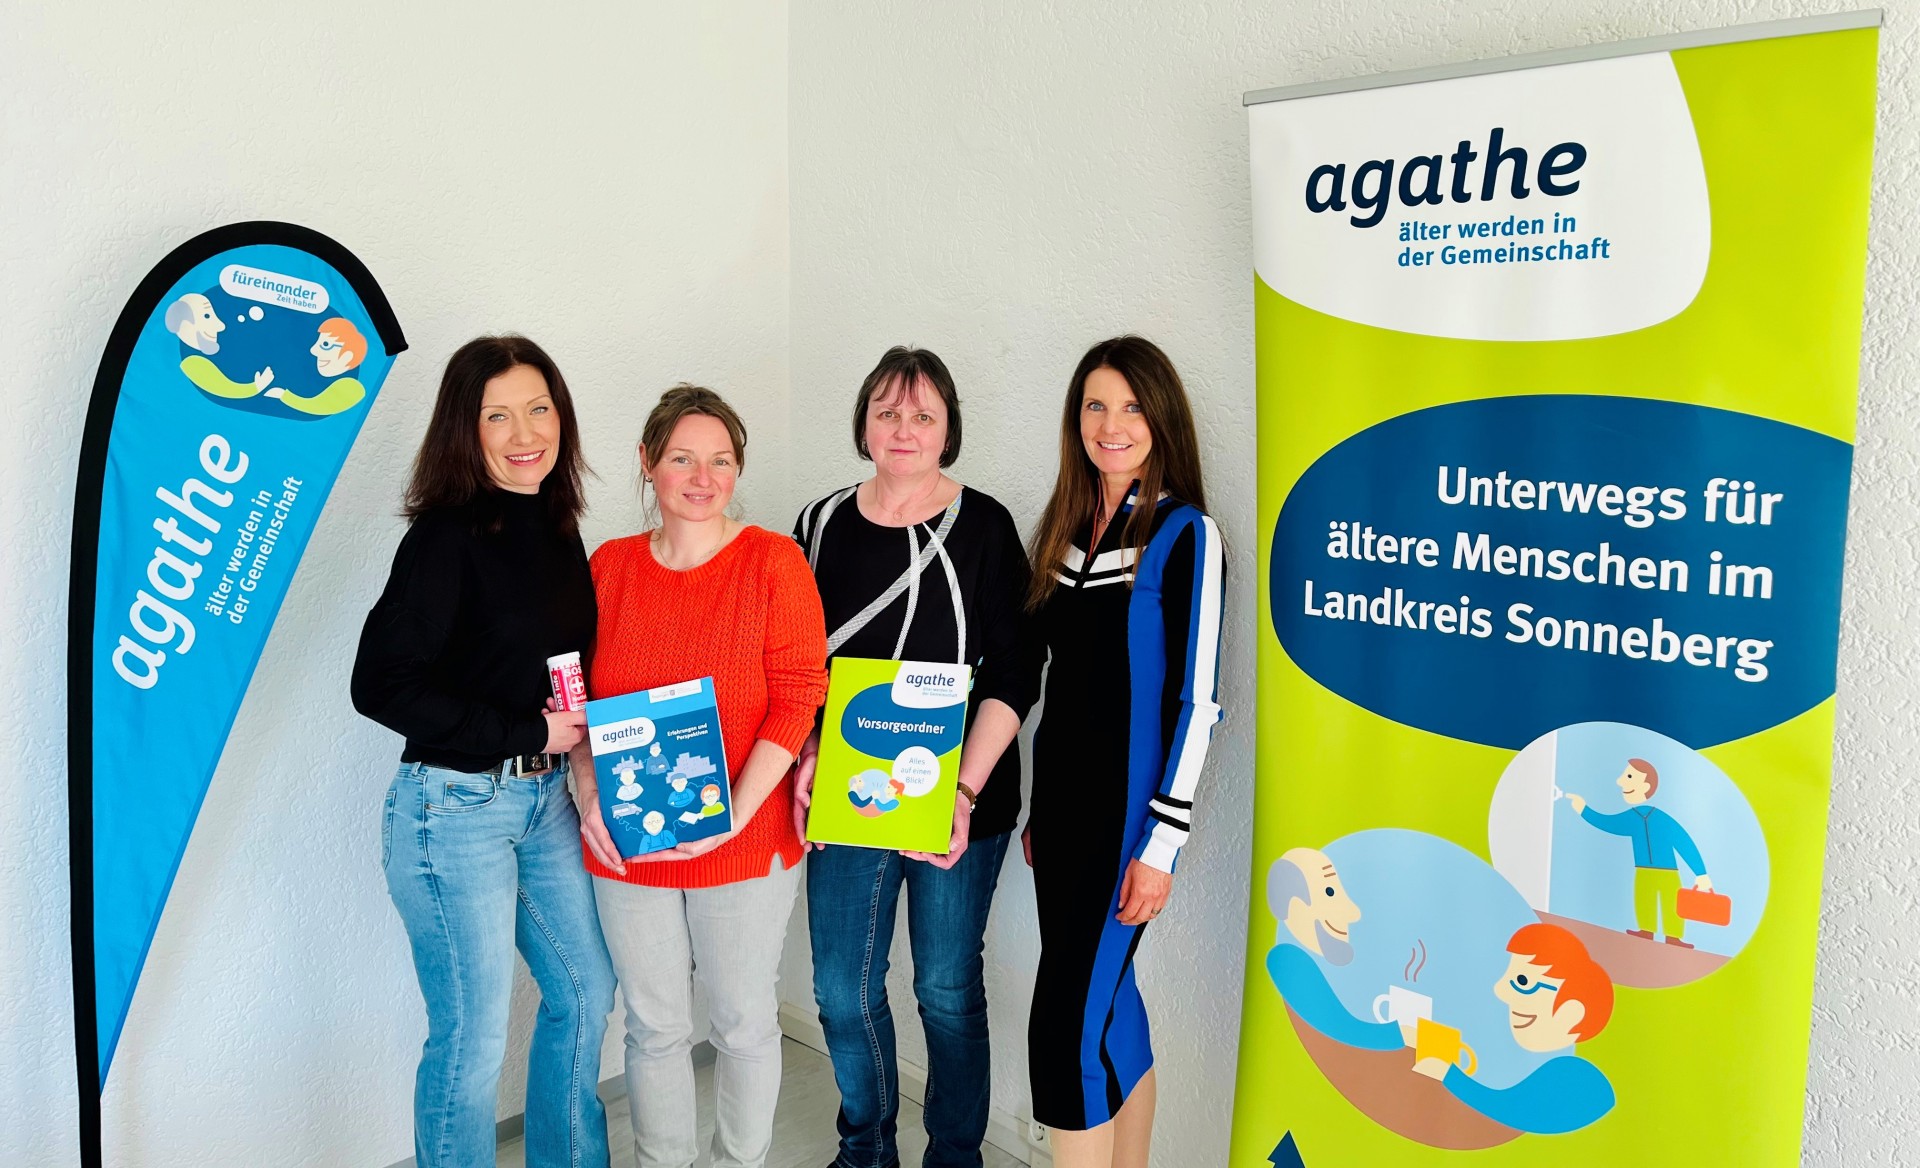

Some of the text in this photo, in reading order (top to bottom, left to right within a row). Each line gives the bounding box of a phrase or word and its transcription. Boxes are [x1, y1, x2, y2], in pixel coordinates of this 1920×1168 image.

[1305, 127, 1587, 228] agathe
[1398, 212, 1576, 241] älter werden in
[1398, 237, 1610, 268] der Gemeinschaft
[232, 270, 317, 300] füreinander
[276, 294, 317, 309] Zeit haben
[1437, 465, 1783, 528] Unterwegs für
[112, 433, 249, 690] agathe
[204, 490, 272, 616] älter werden in
[226, 476, 303, 625] der Gemeinschaft
[1327, 521, 1773, 600] ältere Menschen im
[1304, 580, 1774, 682] Landkreis Sonneberg
[564, 666, 582, 676] SOS
[906, 673, 955, 687] agathe
[602, 726, 644, 743] agathe
[667, 726, 697, 737] Erfahrungen
[676, 729, 708, 740] Perspektiven
[857, 717, 945, 734] Vorsorgeordner
[909, 757, 925, 765] Alles
